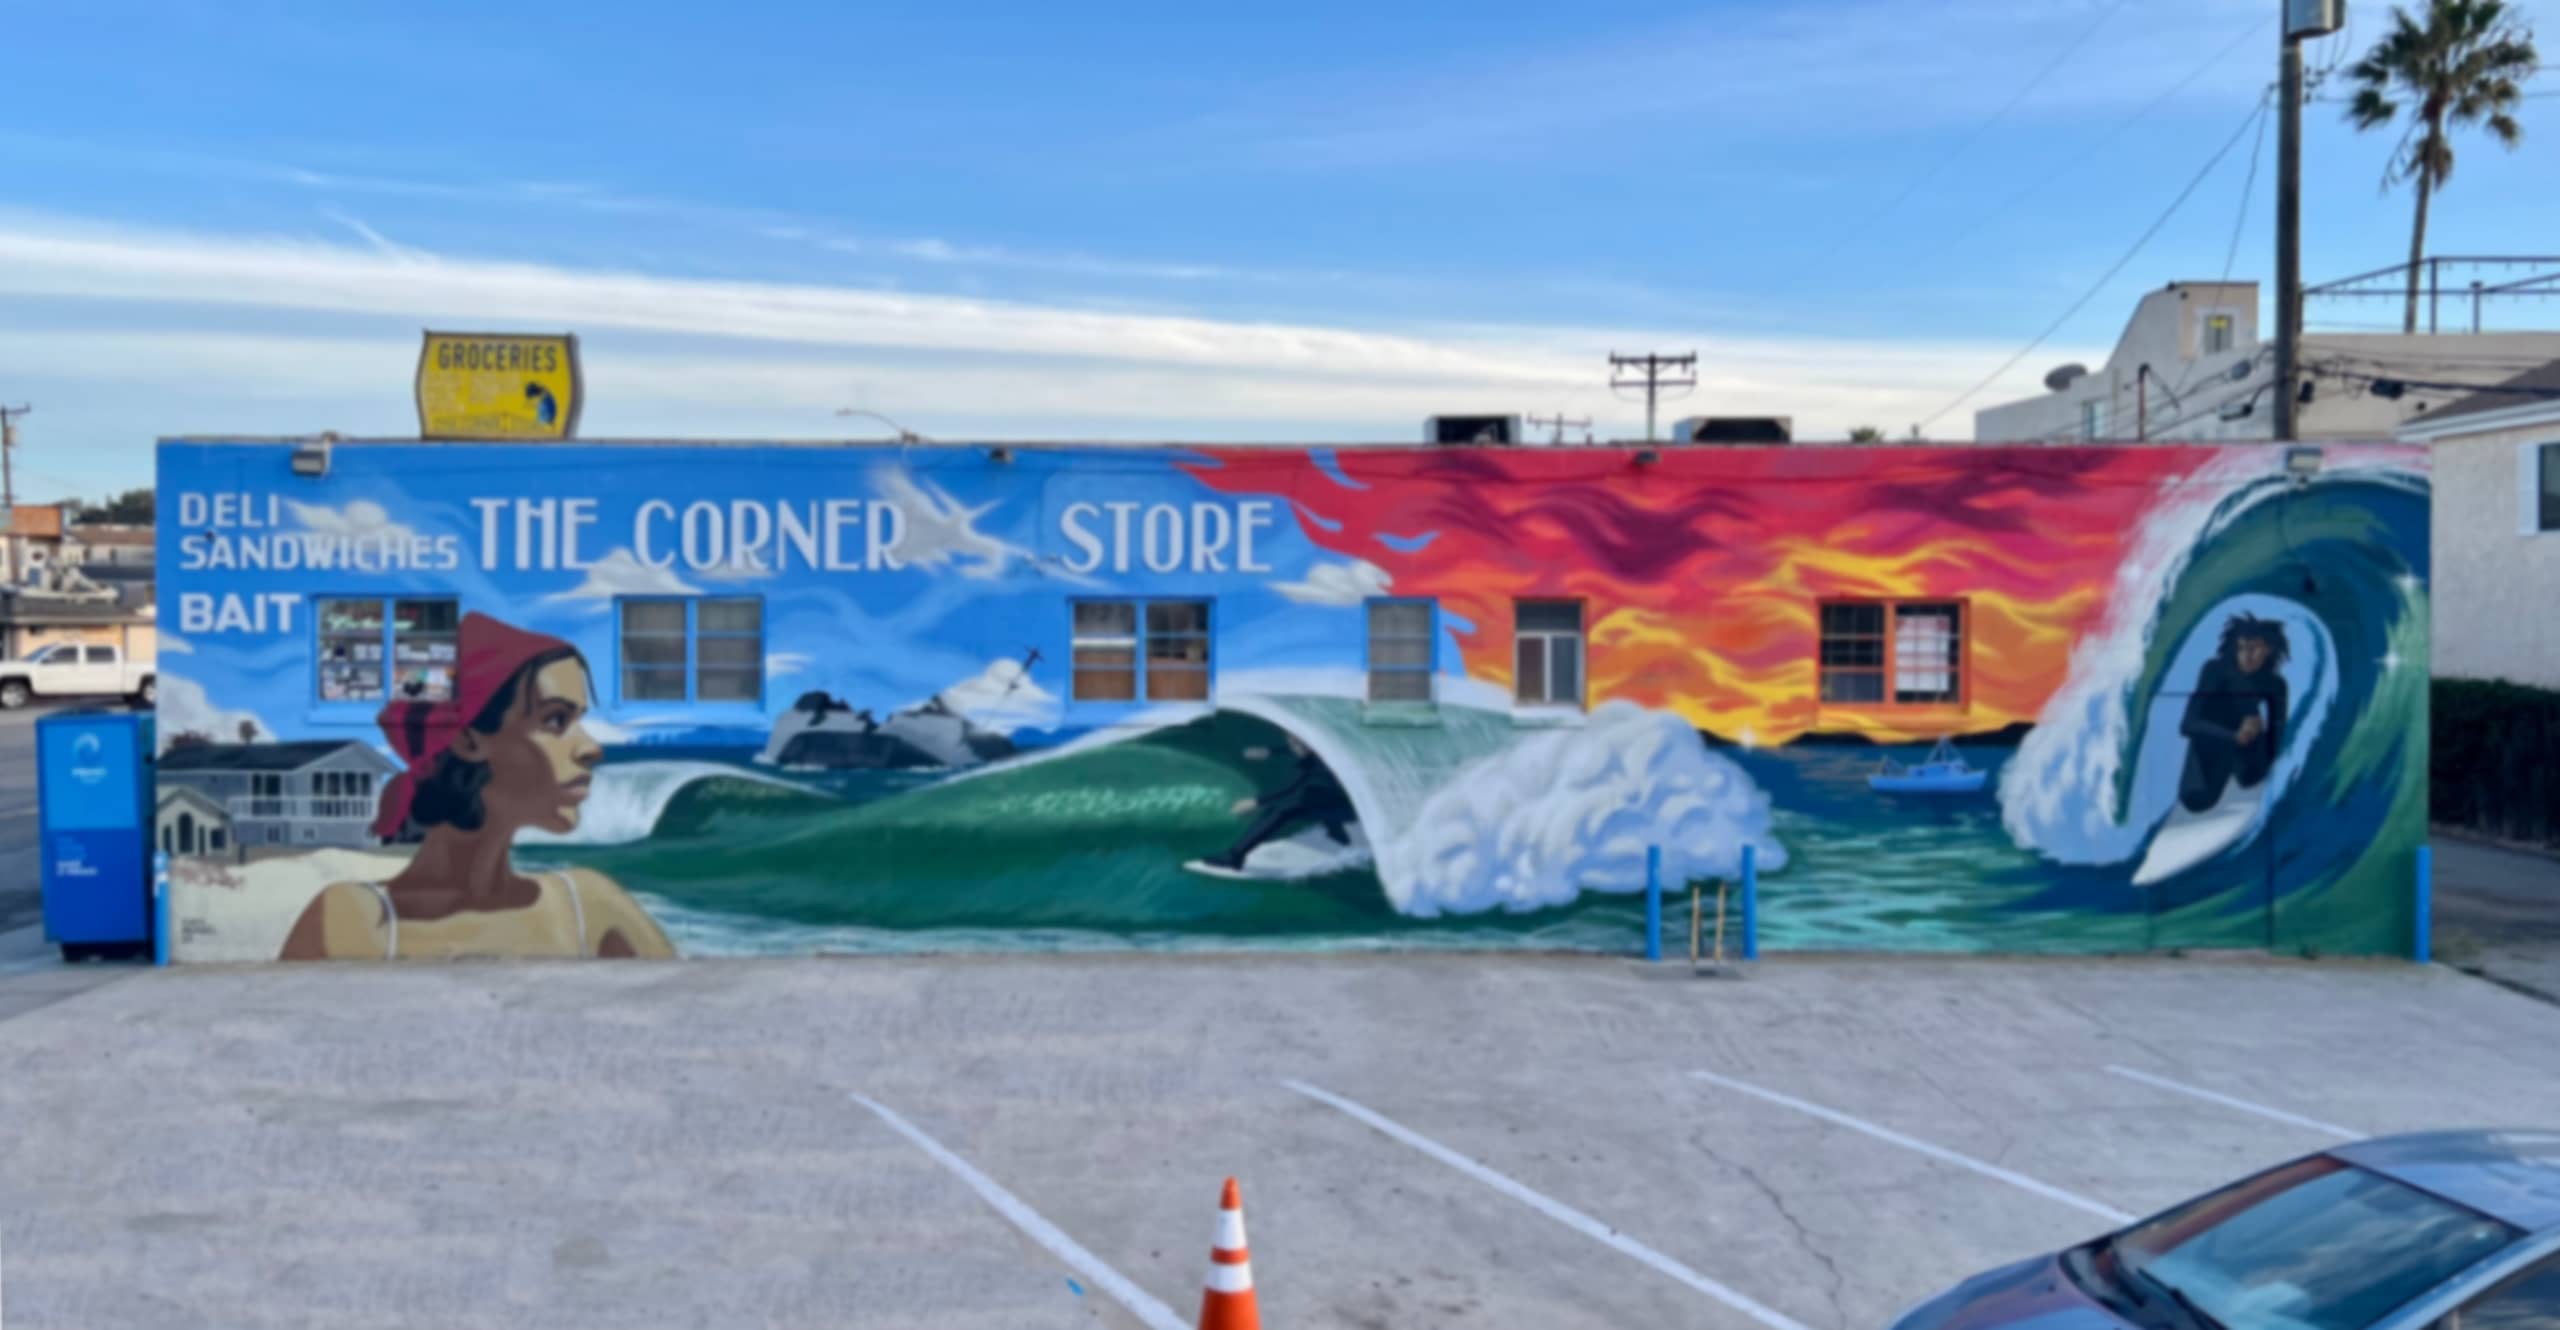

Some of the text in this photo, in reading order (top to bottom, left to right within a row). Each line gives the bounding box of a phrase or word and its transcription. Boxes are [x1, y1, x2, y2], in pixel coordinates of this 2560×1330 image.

[438, 342, 557, 372] GROCERIES
[178, 492, 280, 528] DELI
[179, 535, 460, 571] SANDWICHES
[470, 498, 1274, 573] THE CORNER STORE
[179, 593, 302, 633] BAIT
